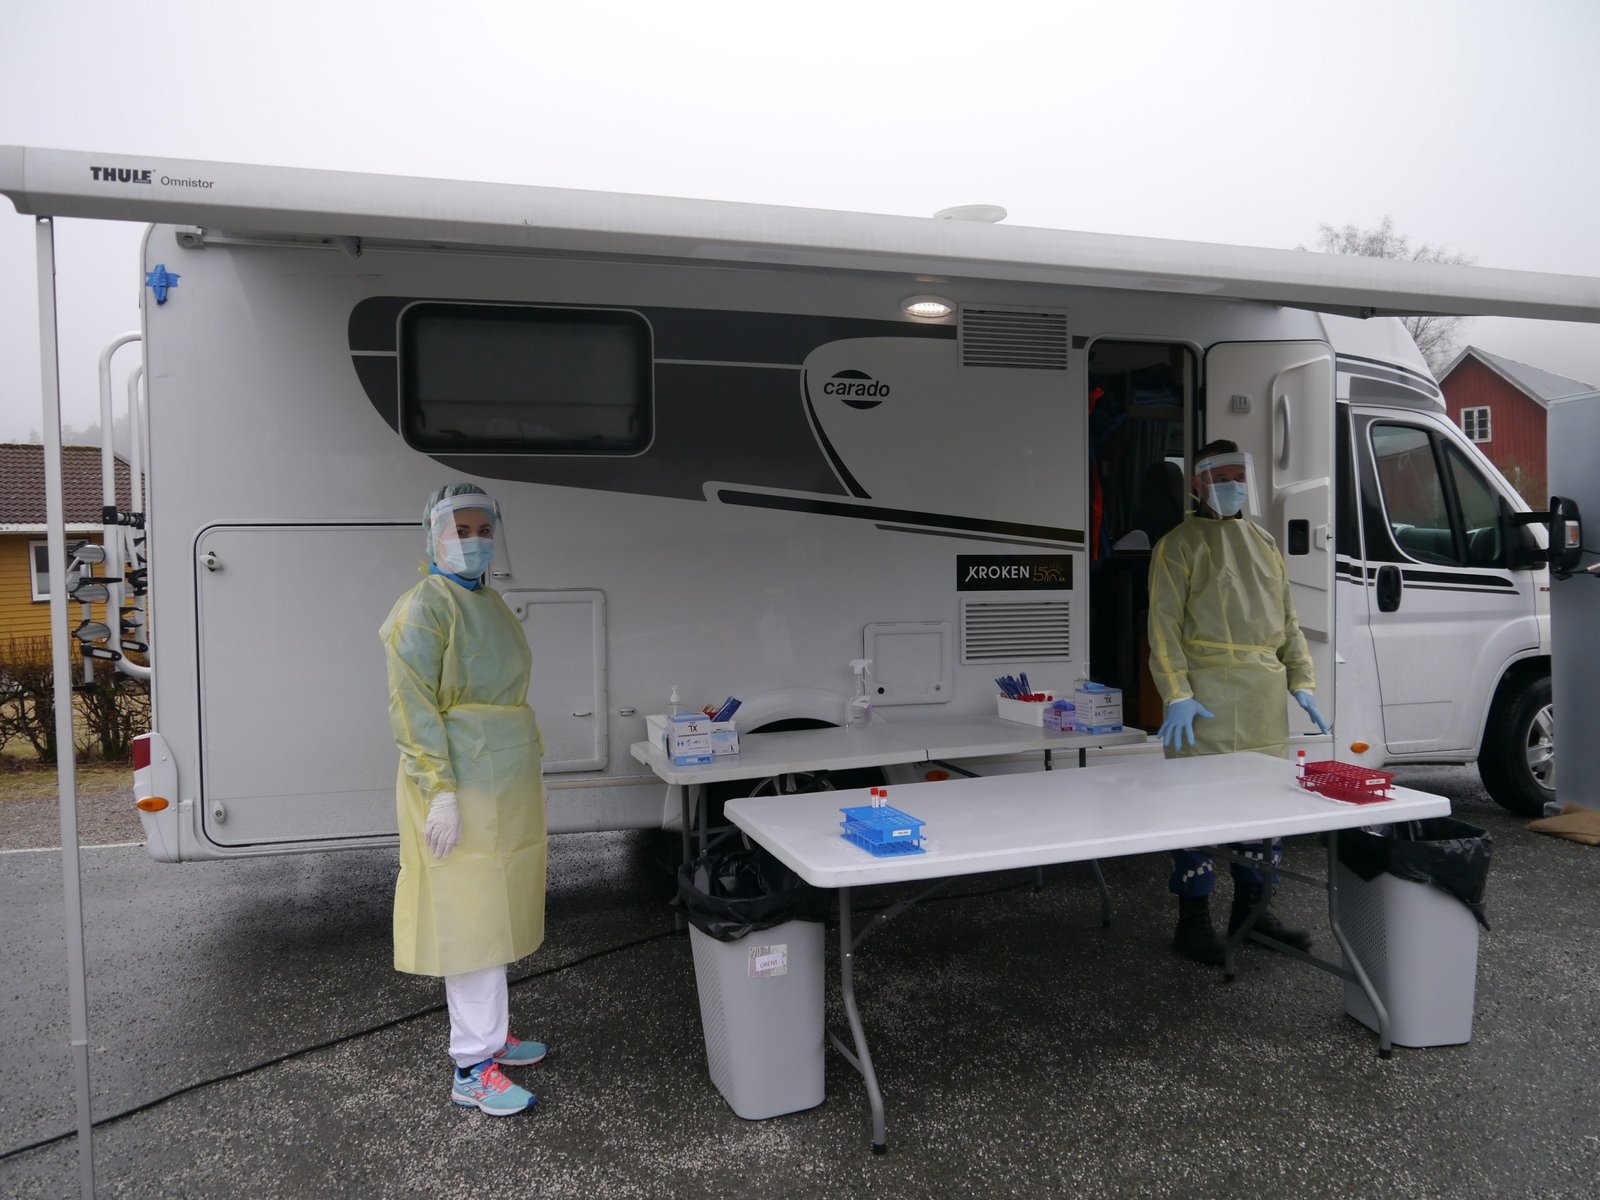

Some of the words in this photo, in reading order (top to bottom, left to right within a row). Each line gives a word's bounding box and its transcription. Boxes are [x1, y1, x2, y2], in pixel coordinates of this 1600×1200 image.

[90, 166, 152, 184] THULE
[160, 175, 215, 189] Omnistor
[823, 380, 890, 397] carado
[965, 565, 1030, 582] KROKEN
